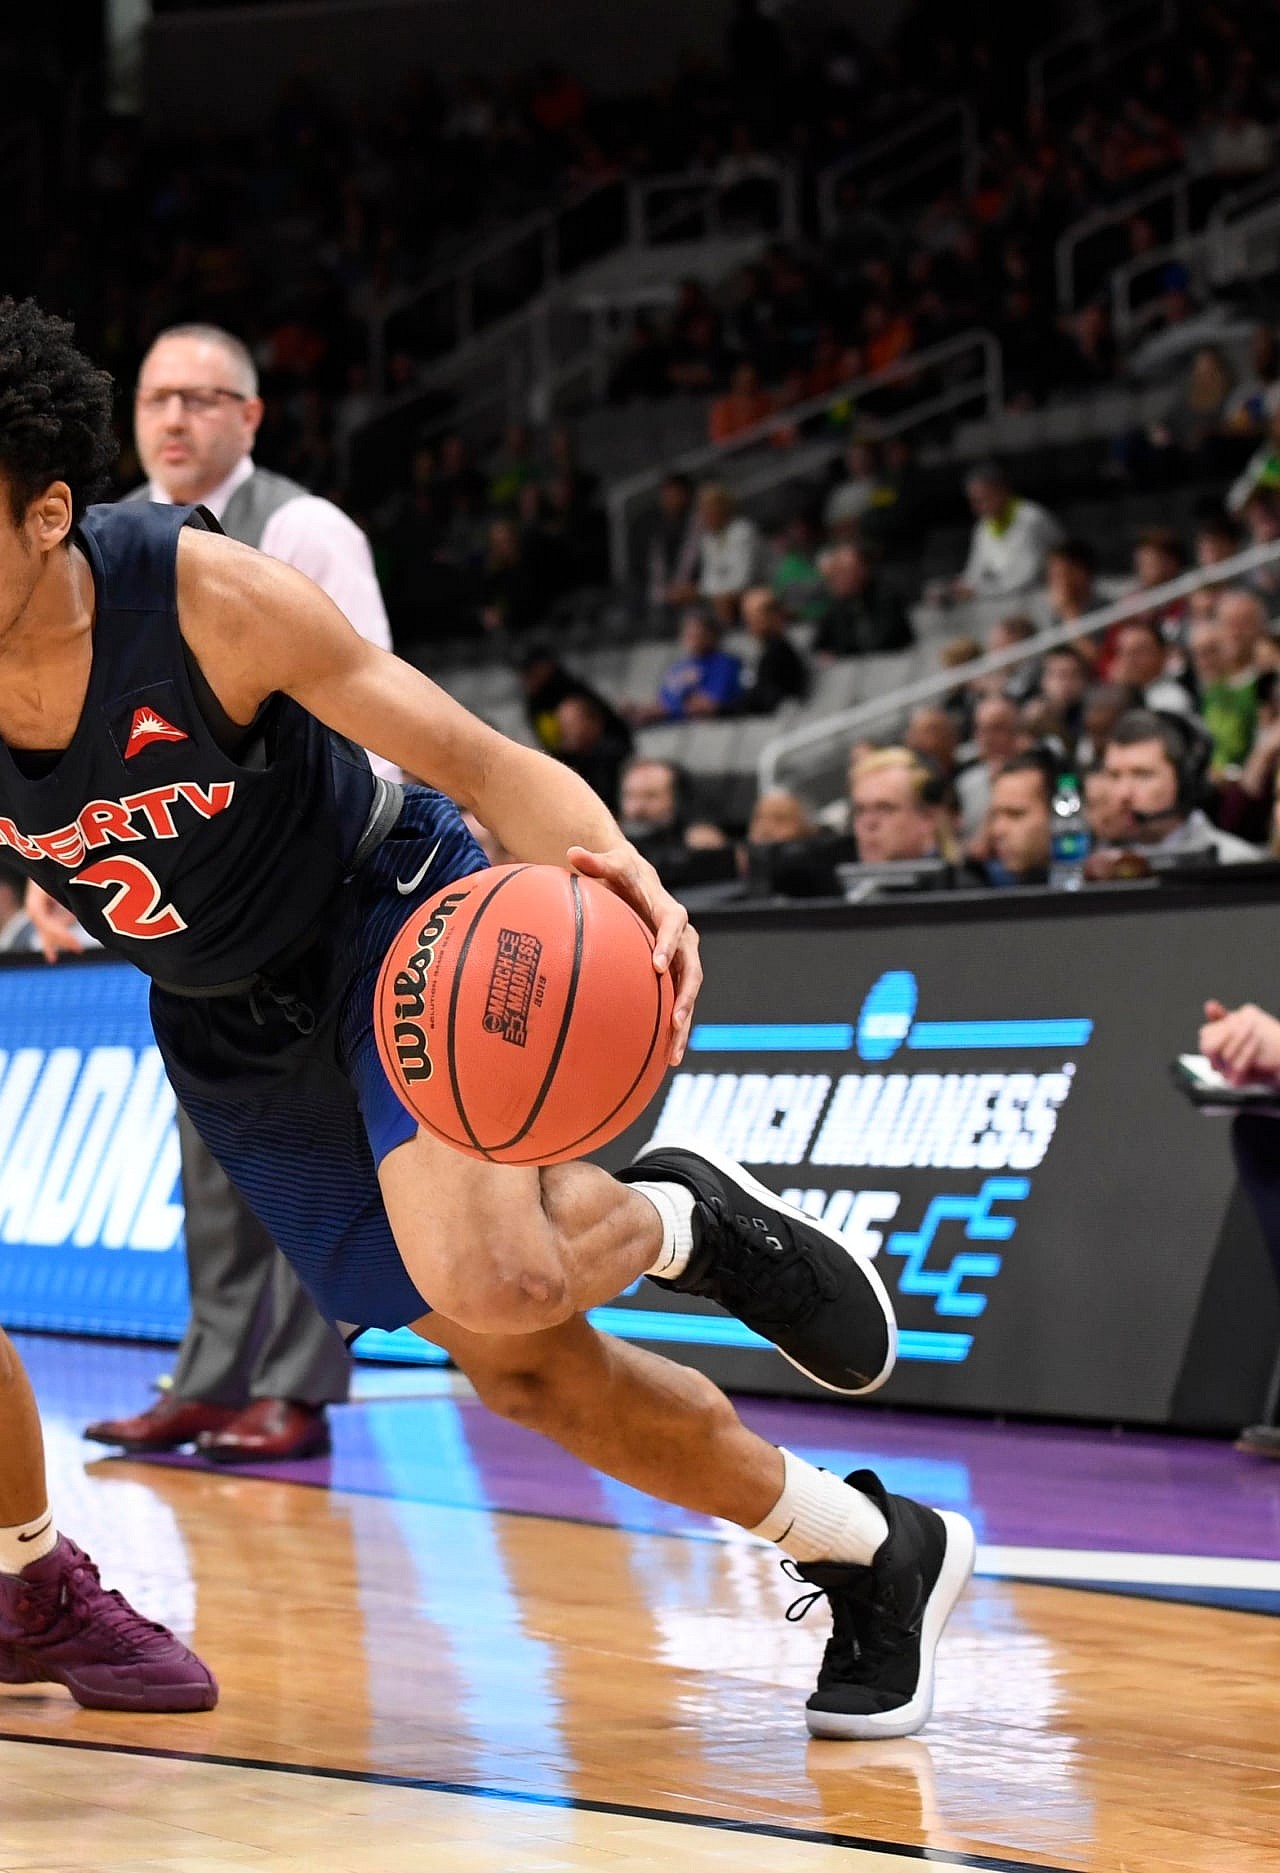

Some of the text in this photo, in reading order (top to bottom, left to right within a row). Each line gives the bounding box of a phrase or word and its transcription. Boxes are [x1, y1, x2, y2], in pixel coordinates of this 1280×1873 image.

[69, 855, 188, 939] 2
[394, 889, 472, 1087] Wilson
[487, 955, 514, 1016] MARCH
[505, 932, 538, 1014] MADNESS
[810, 1073, 1072, 1168] MADNESS
